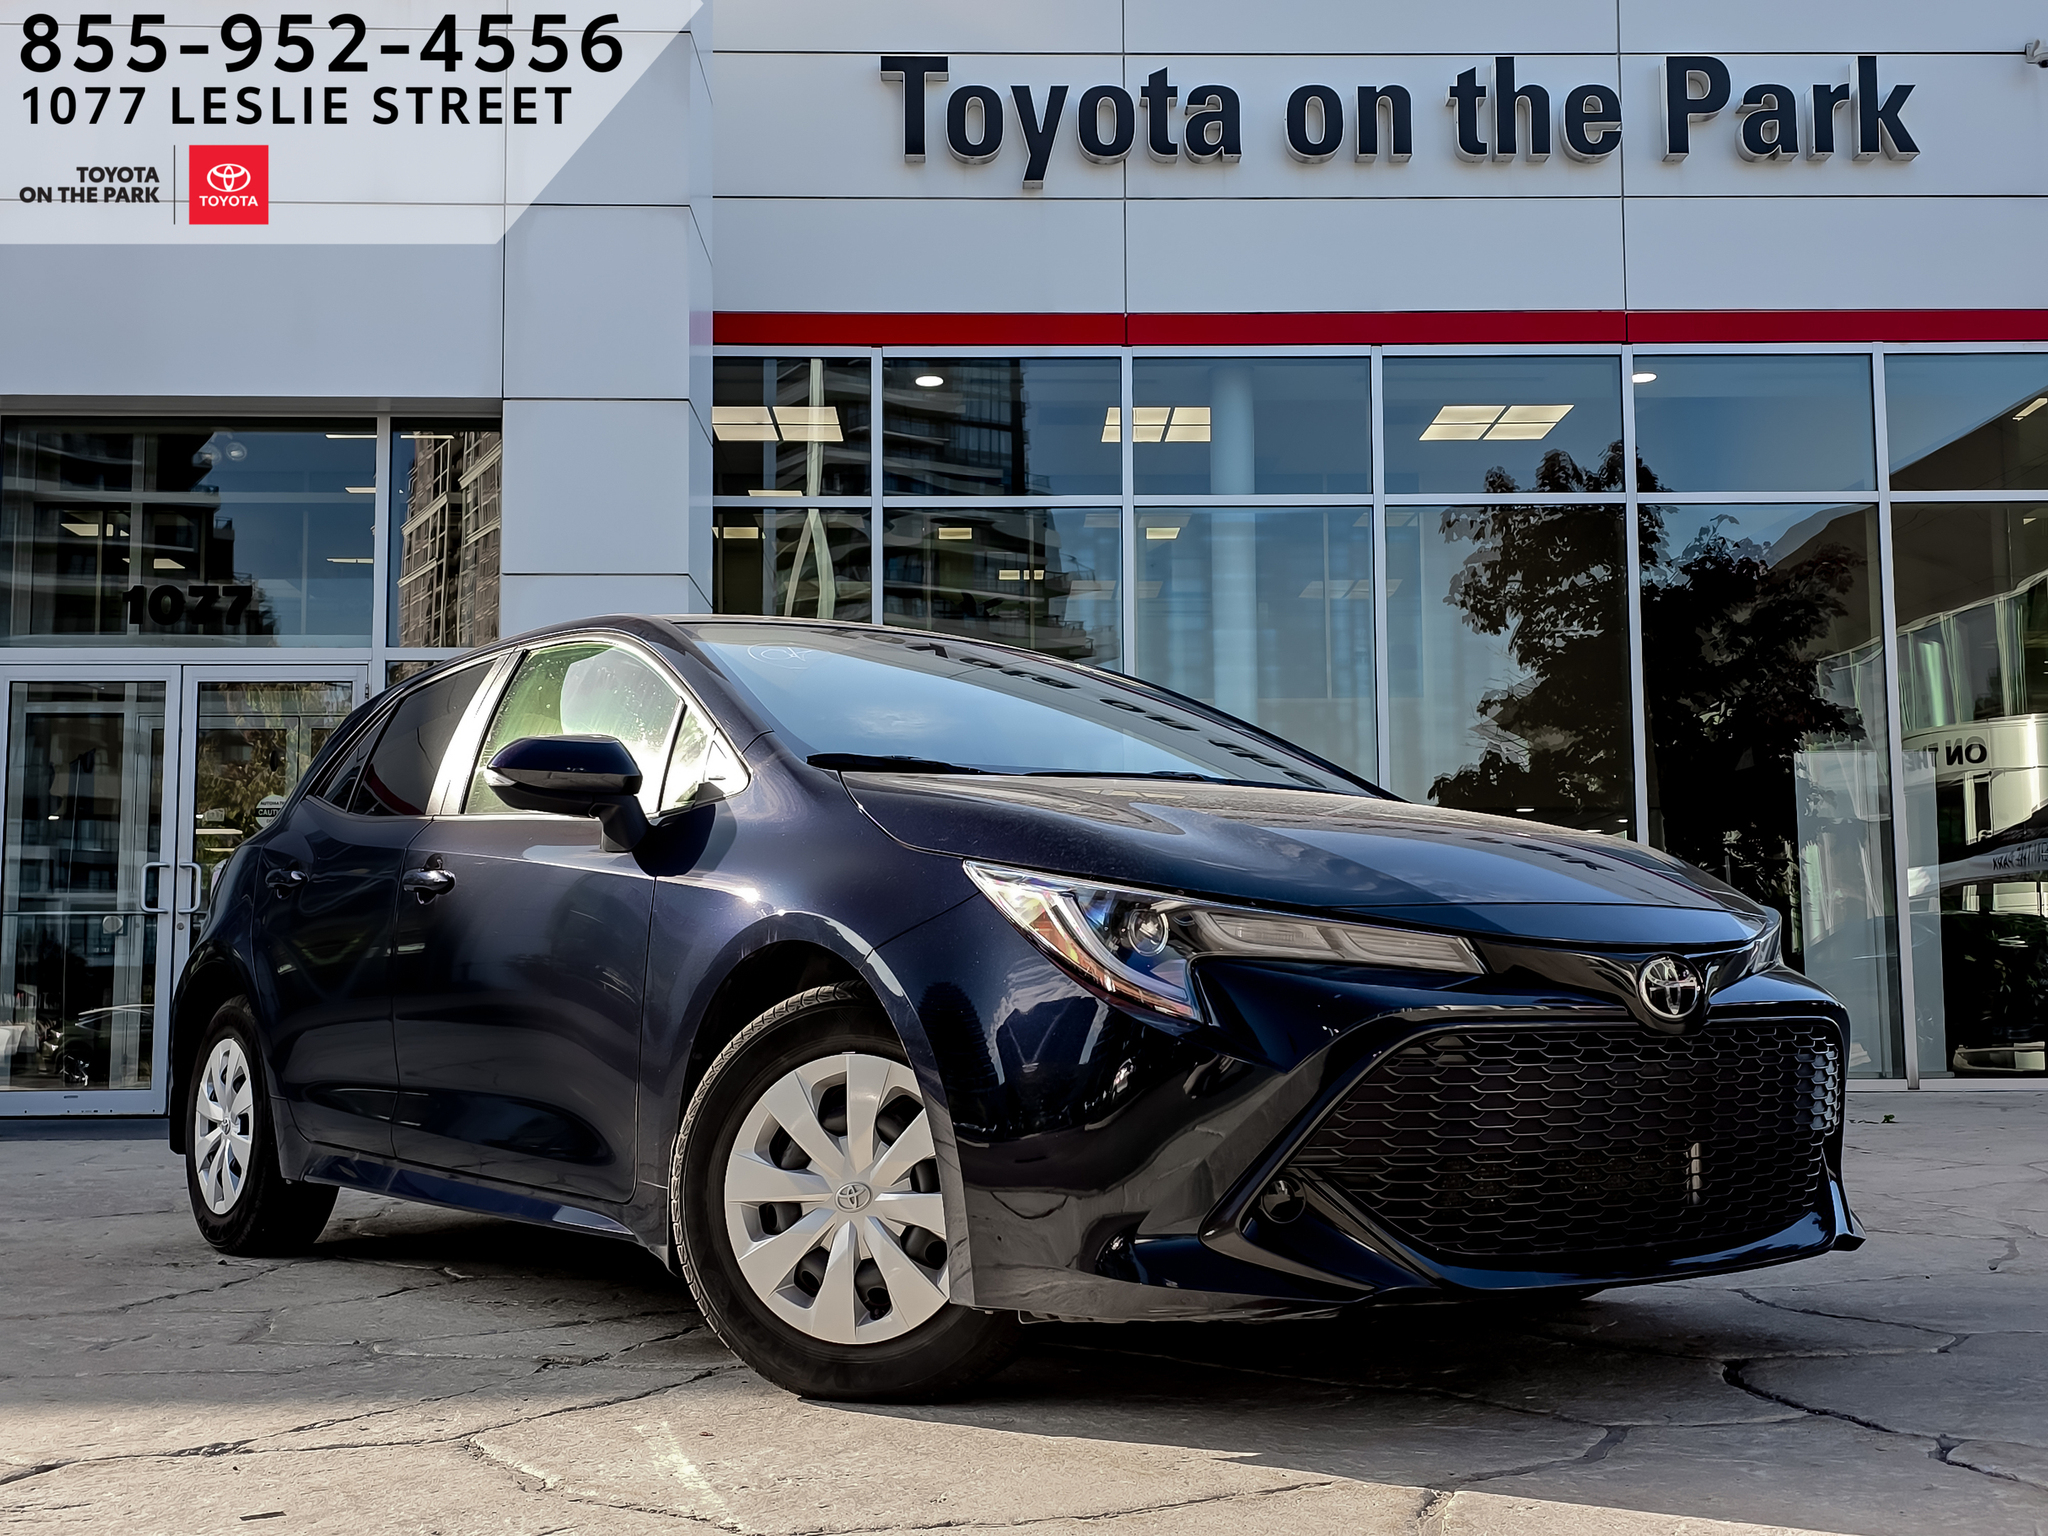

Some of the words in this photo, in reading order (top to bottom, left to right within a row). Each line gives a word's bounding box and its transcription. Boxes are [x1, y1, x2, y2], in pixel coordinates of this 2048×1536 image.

[881, 55, 1242, 186] Toyota
[1287, 84, 1413, 162] on
[1449, 56, 1622, 162] the
[1663, 56, 1920, 162] Park
[122, 585, 253, 625] 1077
